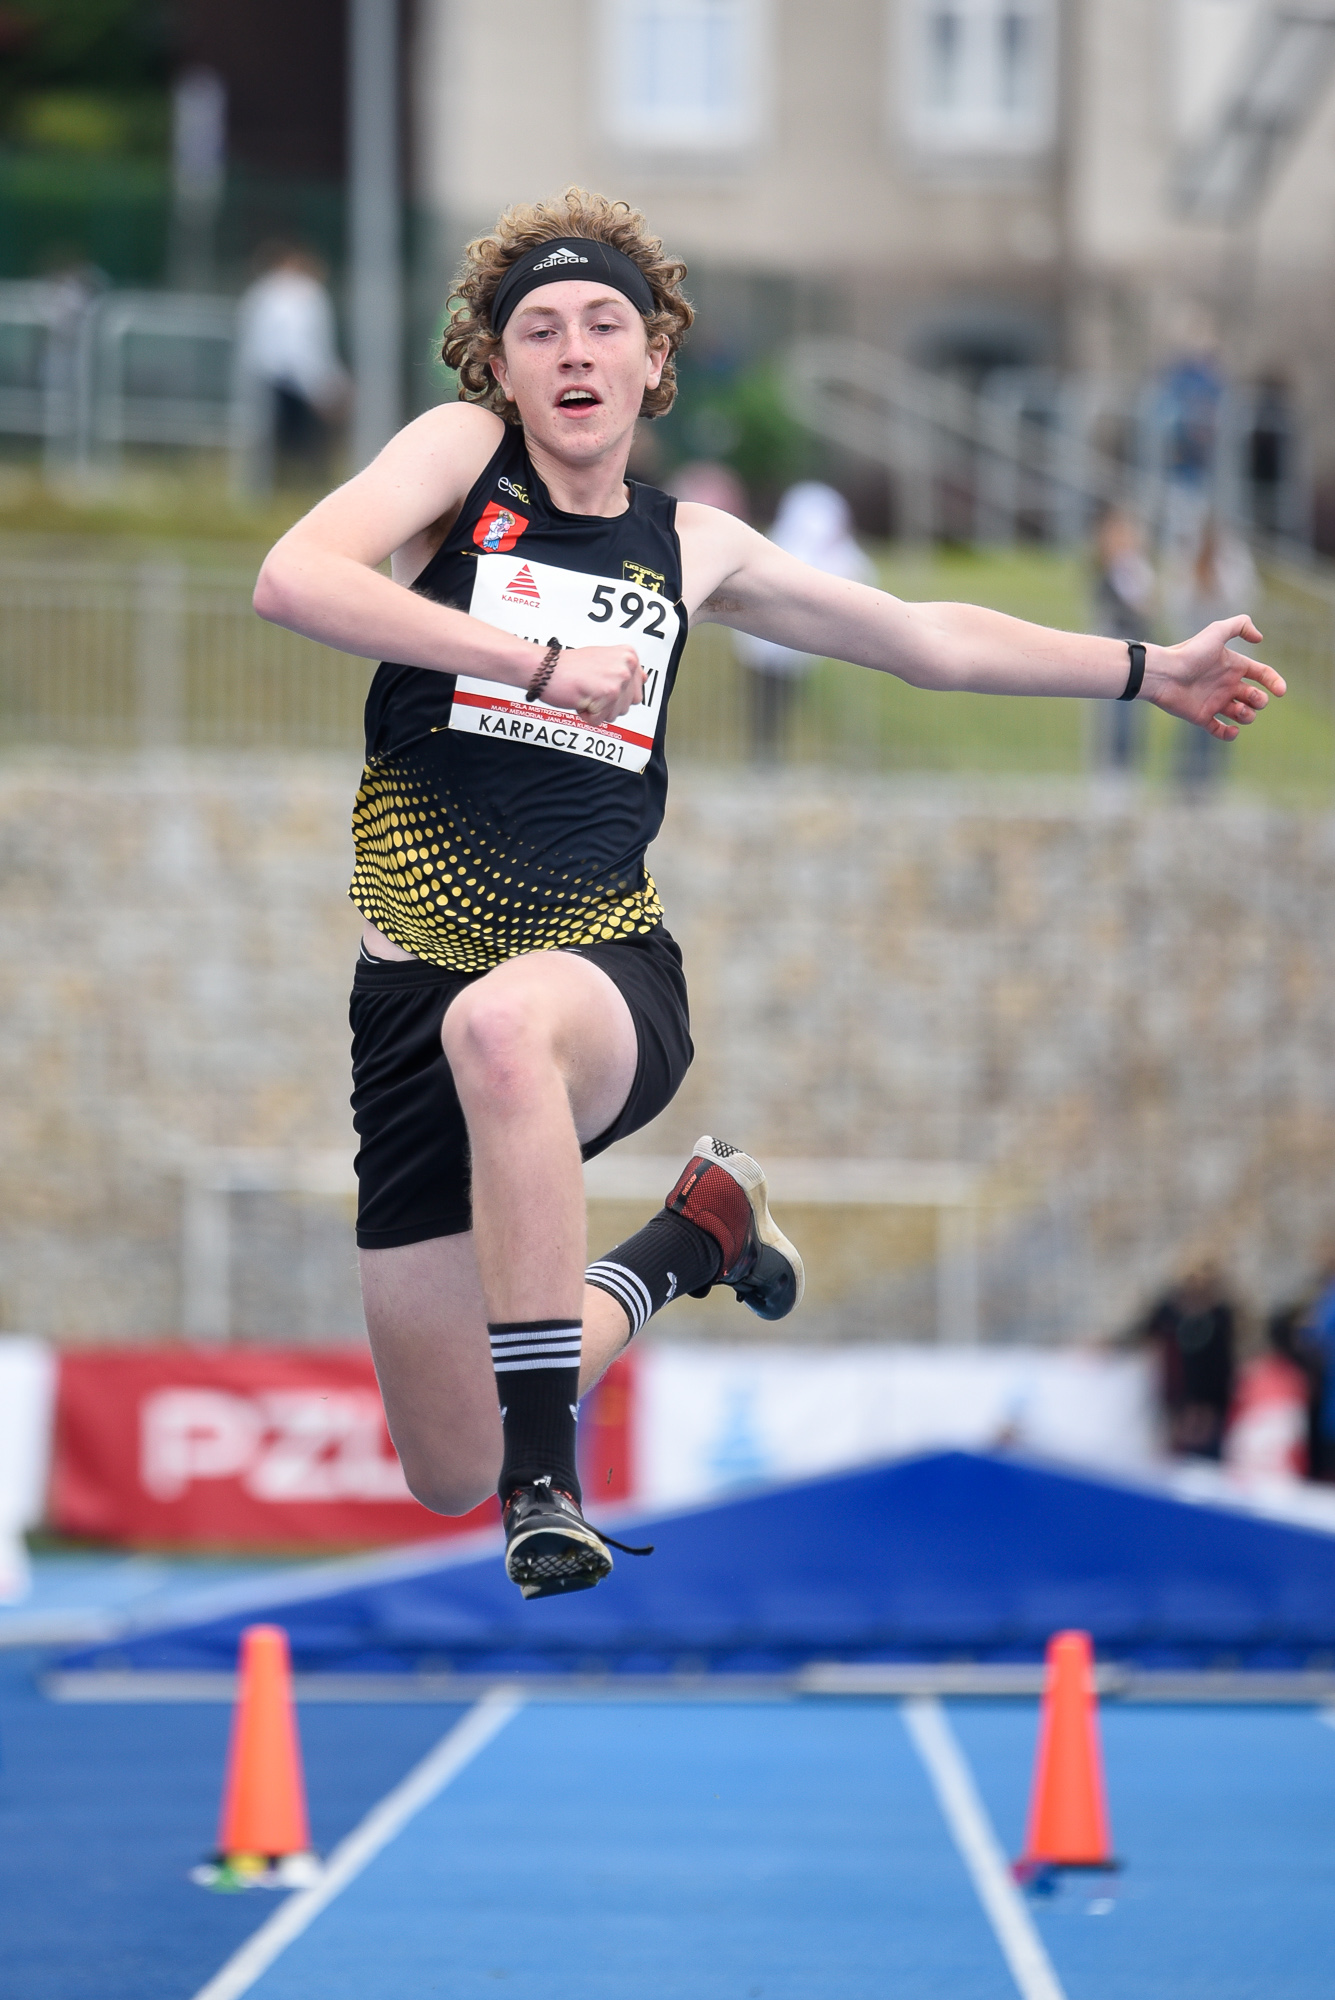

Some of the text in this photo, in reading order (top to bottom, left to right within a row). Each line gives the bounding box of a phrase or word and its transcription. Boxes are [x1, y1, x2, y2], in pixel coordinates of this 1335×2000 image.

[532, 256, 589, 271] adidas
[501, 594, 541, 609] KARPACZ
[587, 584, 666, 640] 592
[545, 715, 576, 727] JANUSZA
[478, 714, 624, 763] KARPACZ 2021
[143, 1388, 413, 1502] PZL
